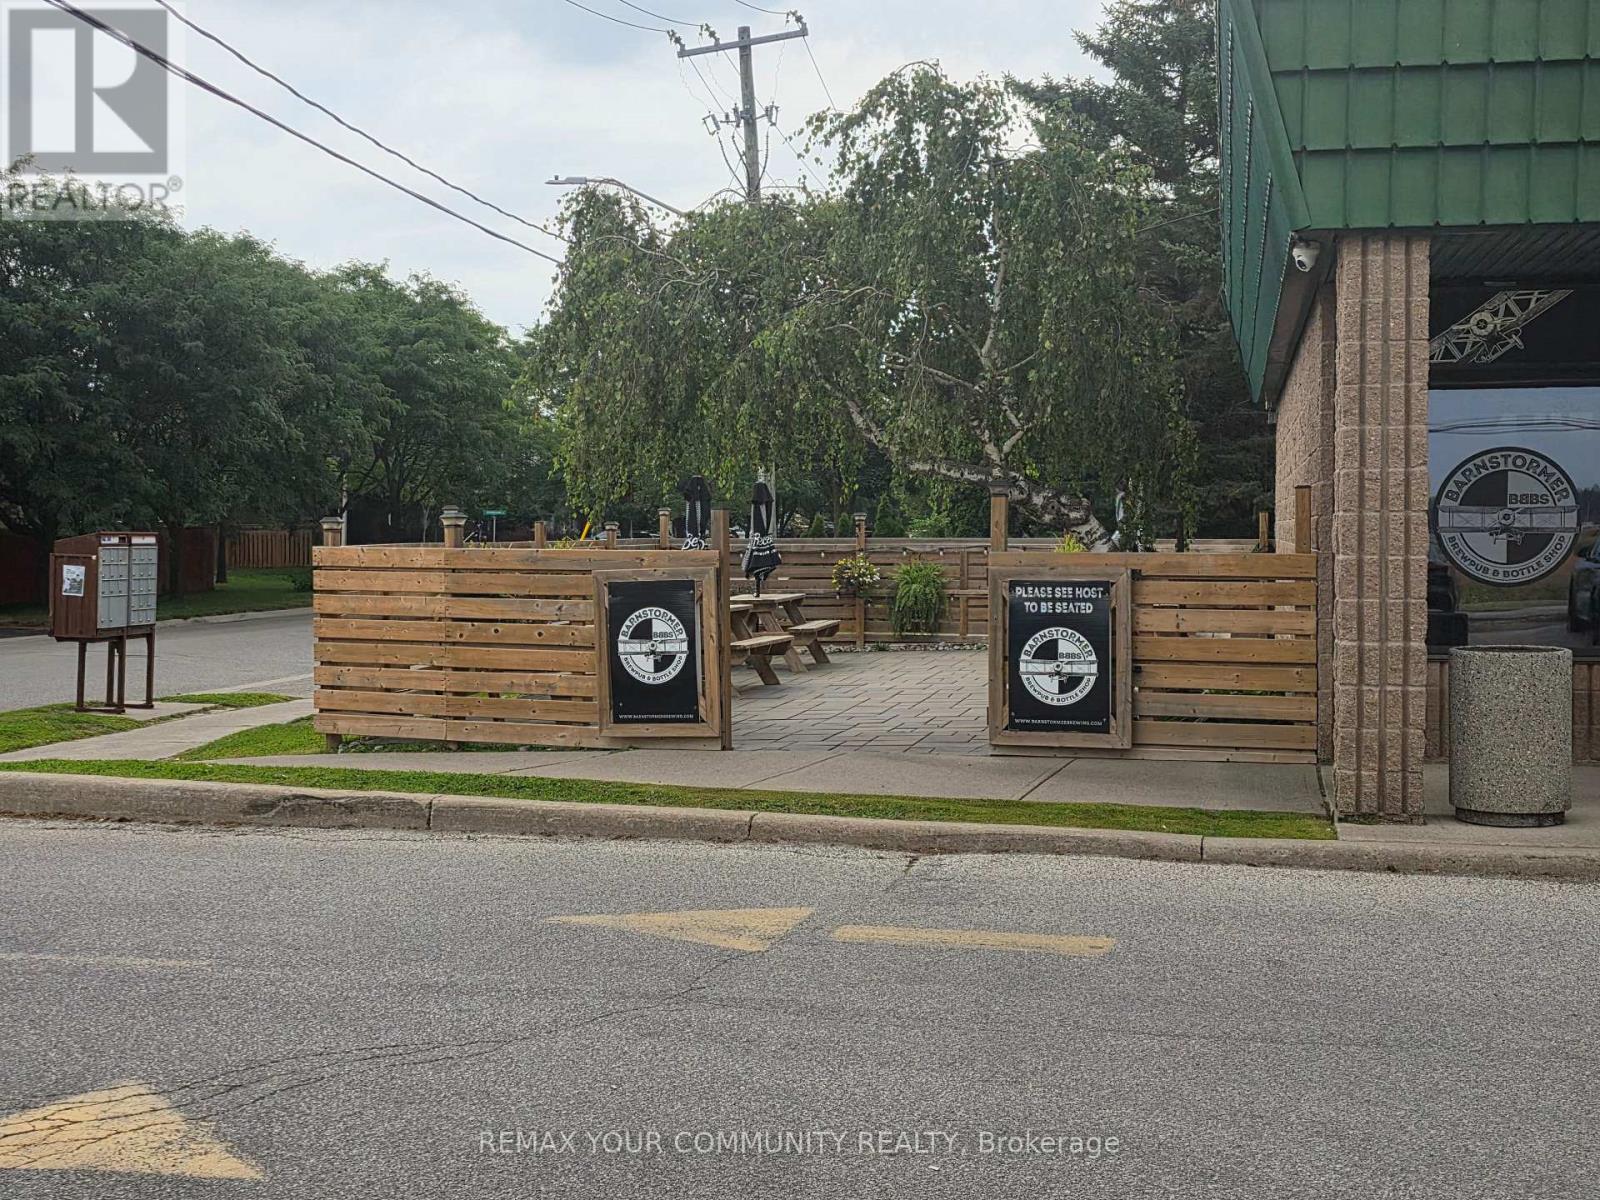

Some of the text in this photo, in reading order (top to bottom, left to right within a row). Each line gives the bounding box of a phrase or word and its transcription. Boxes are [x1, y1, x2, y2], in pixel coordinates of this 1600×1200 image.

[1444, 453, 1570, 503] BARNSTORMER
[1448, 535, 1567, 578] BREWPUB & BOTTLE SHOP
[1015, 586, 1104, 599] PLEASE SEE HOST
[1024, 602, 1094, 614] TO BE SEATED
[621, 609, 684, 638] BARNSTORMER
[1023, 629, 1093, 658] BARNSTORMER
[623, 656, 647, 682] BREWPUB
[652, 671, 673, 682] BOTTLE
[672, 655, 683, 673] SHOP
[1025, 676, 1050, 702] BREWPUB
[1056, 692, 1079, 703] BOTTLE
[1078, 677, 1092, 694] SHOP
